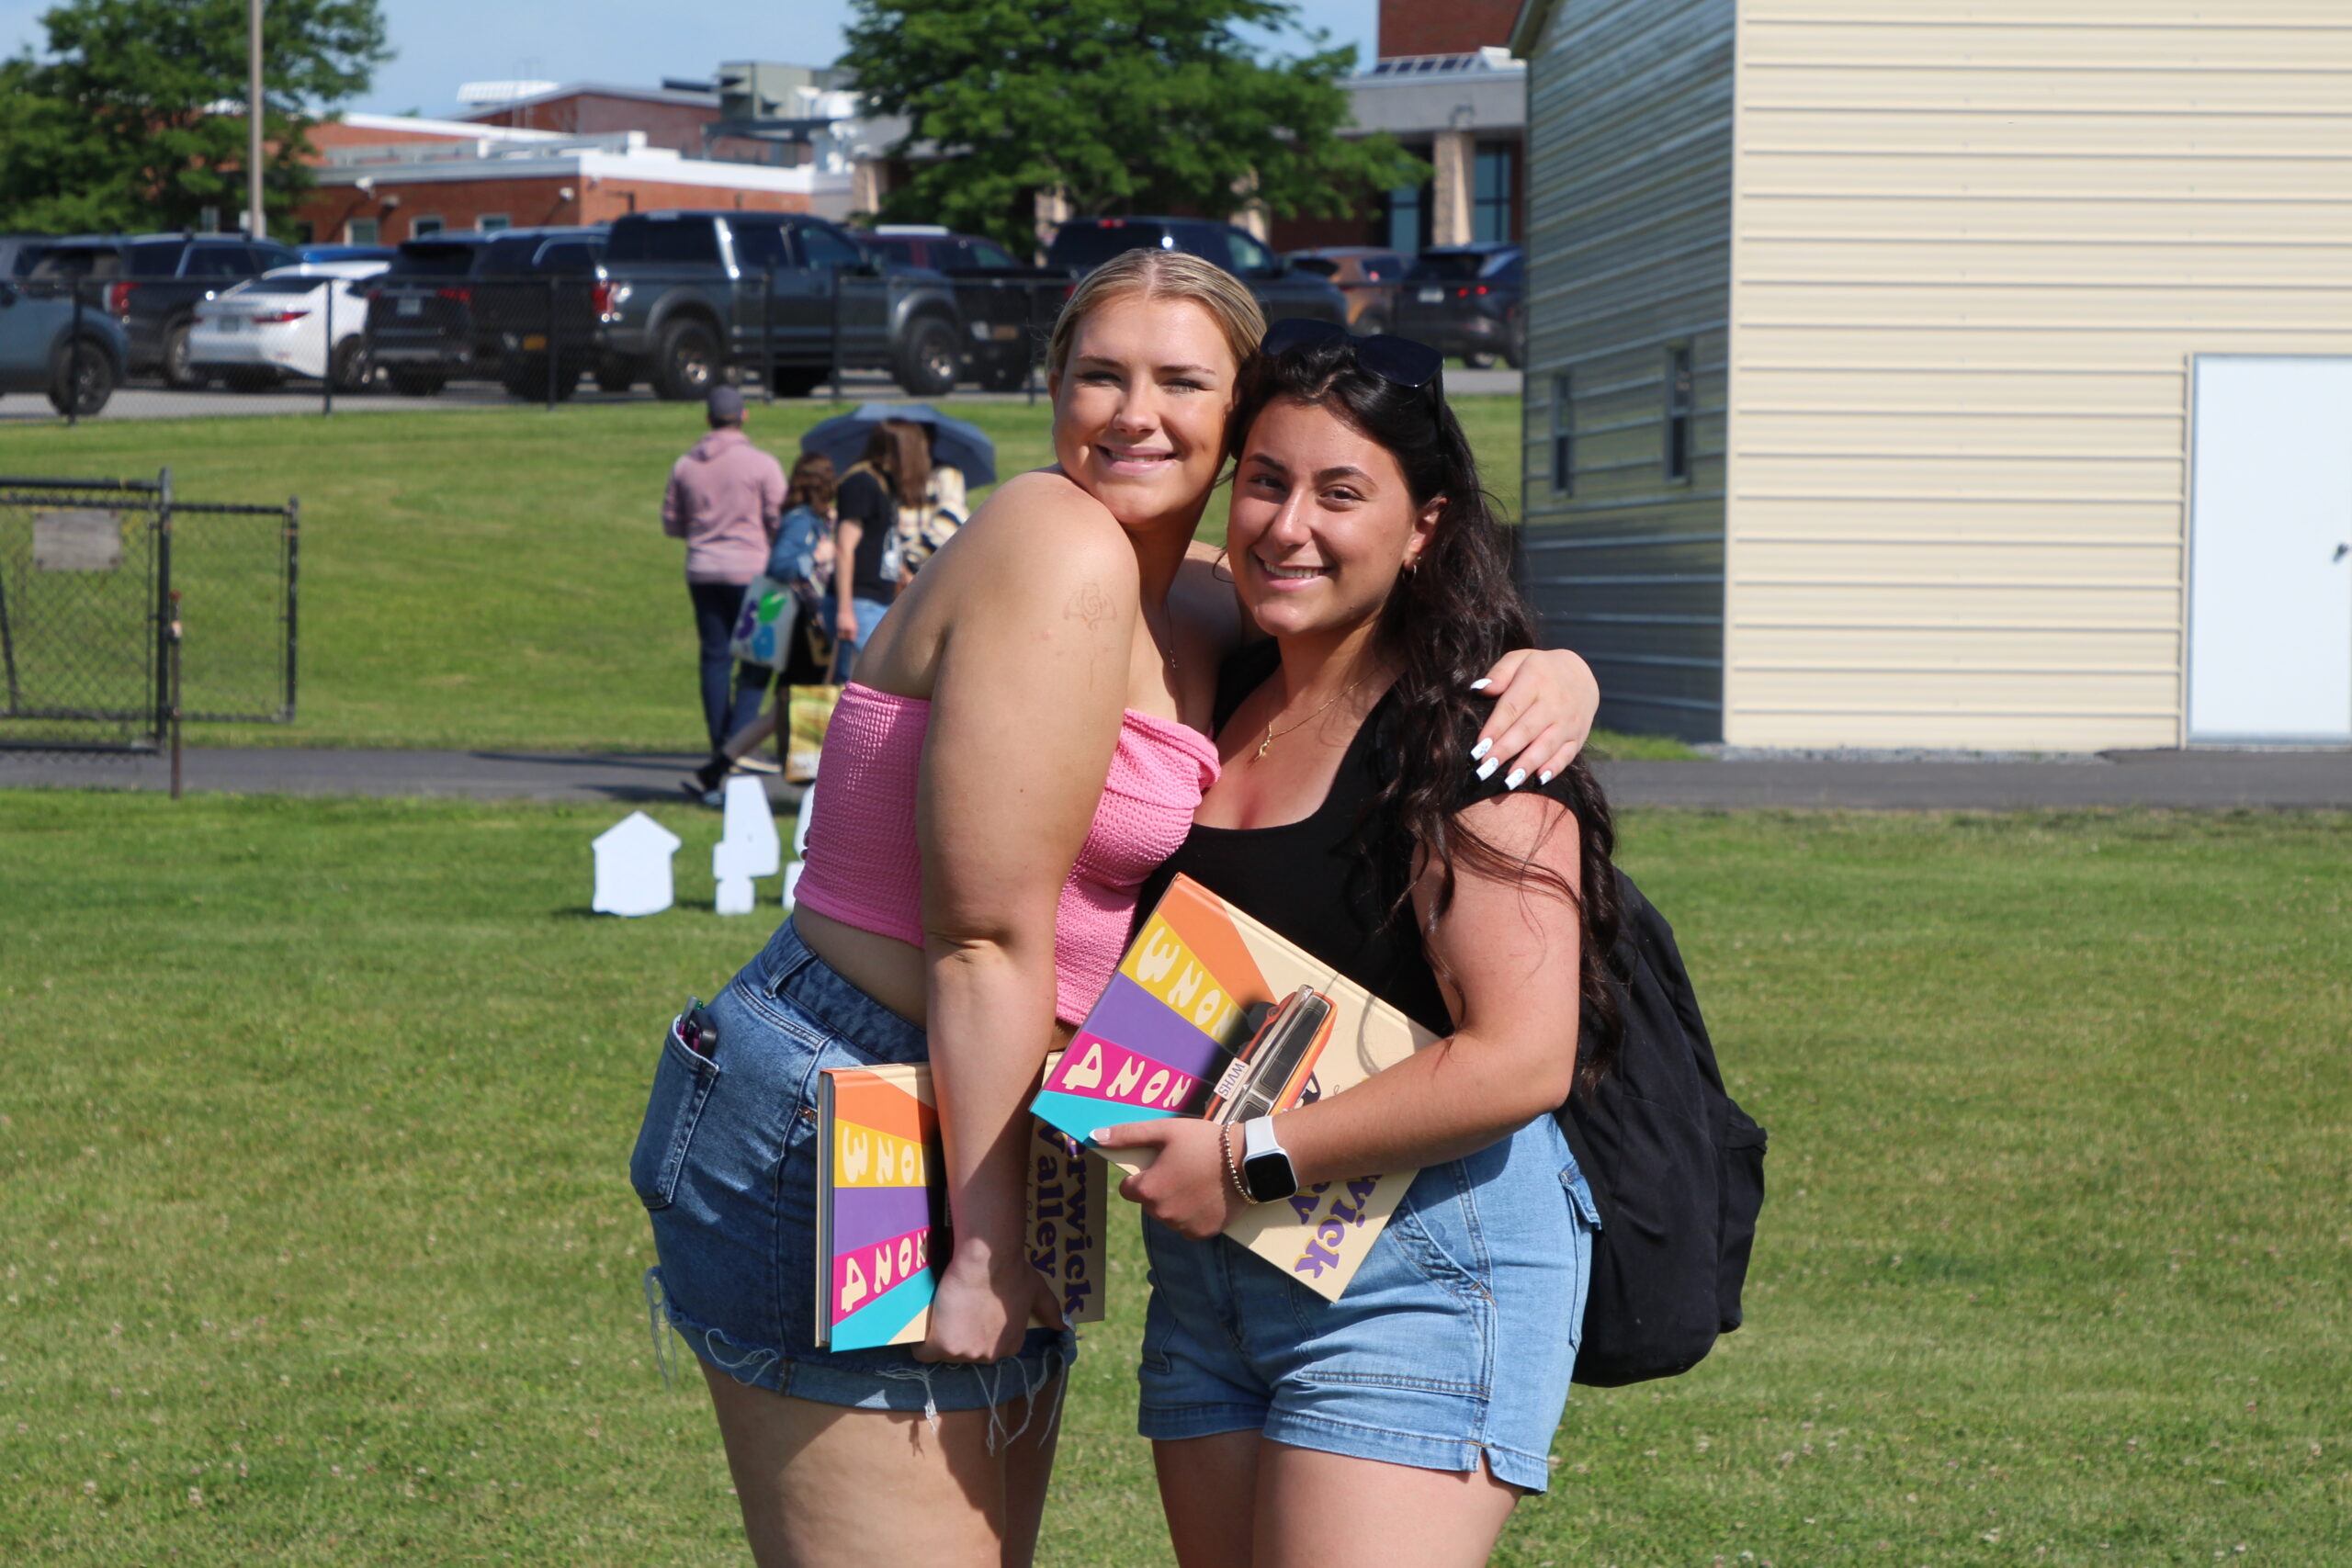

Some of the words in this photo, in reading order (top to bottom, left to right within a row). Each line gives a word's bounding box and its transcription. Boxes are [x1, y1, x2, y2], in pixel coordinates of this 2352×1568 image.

[1136, 927, 1236, 1039] 2023
[1062, 1043, 1192, 1108] 2024
[1218, 1062, 1246, 1097] WVHS
[1029, 1122, 1066, 1279] Valley
[1063, 1137, 1092, 1314] arwick
[1295, 1175, 1382, 1279] wick
[841, 1230, 929, 1313] 2024
